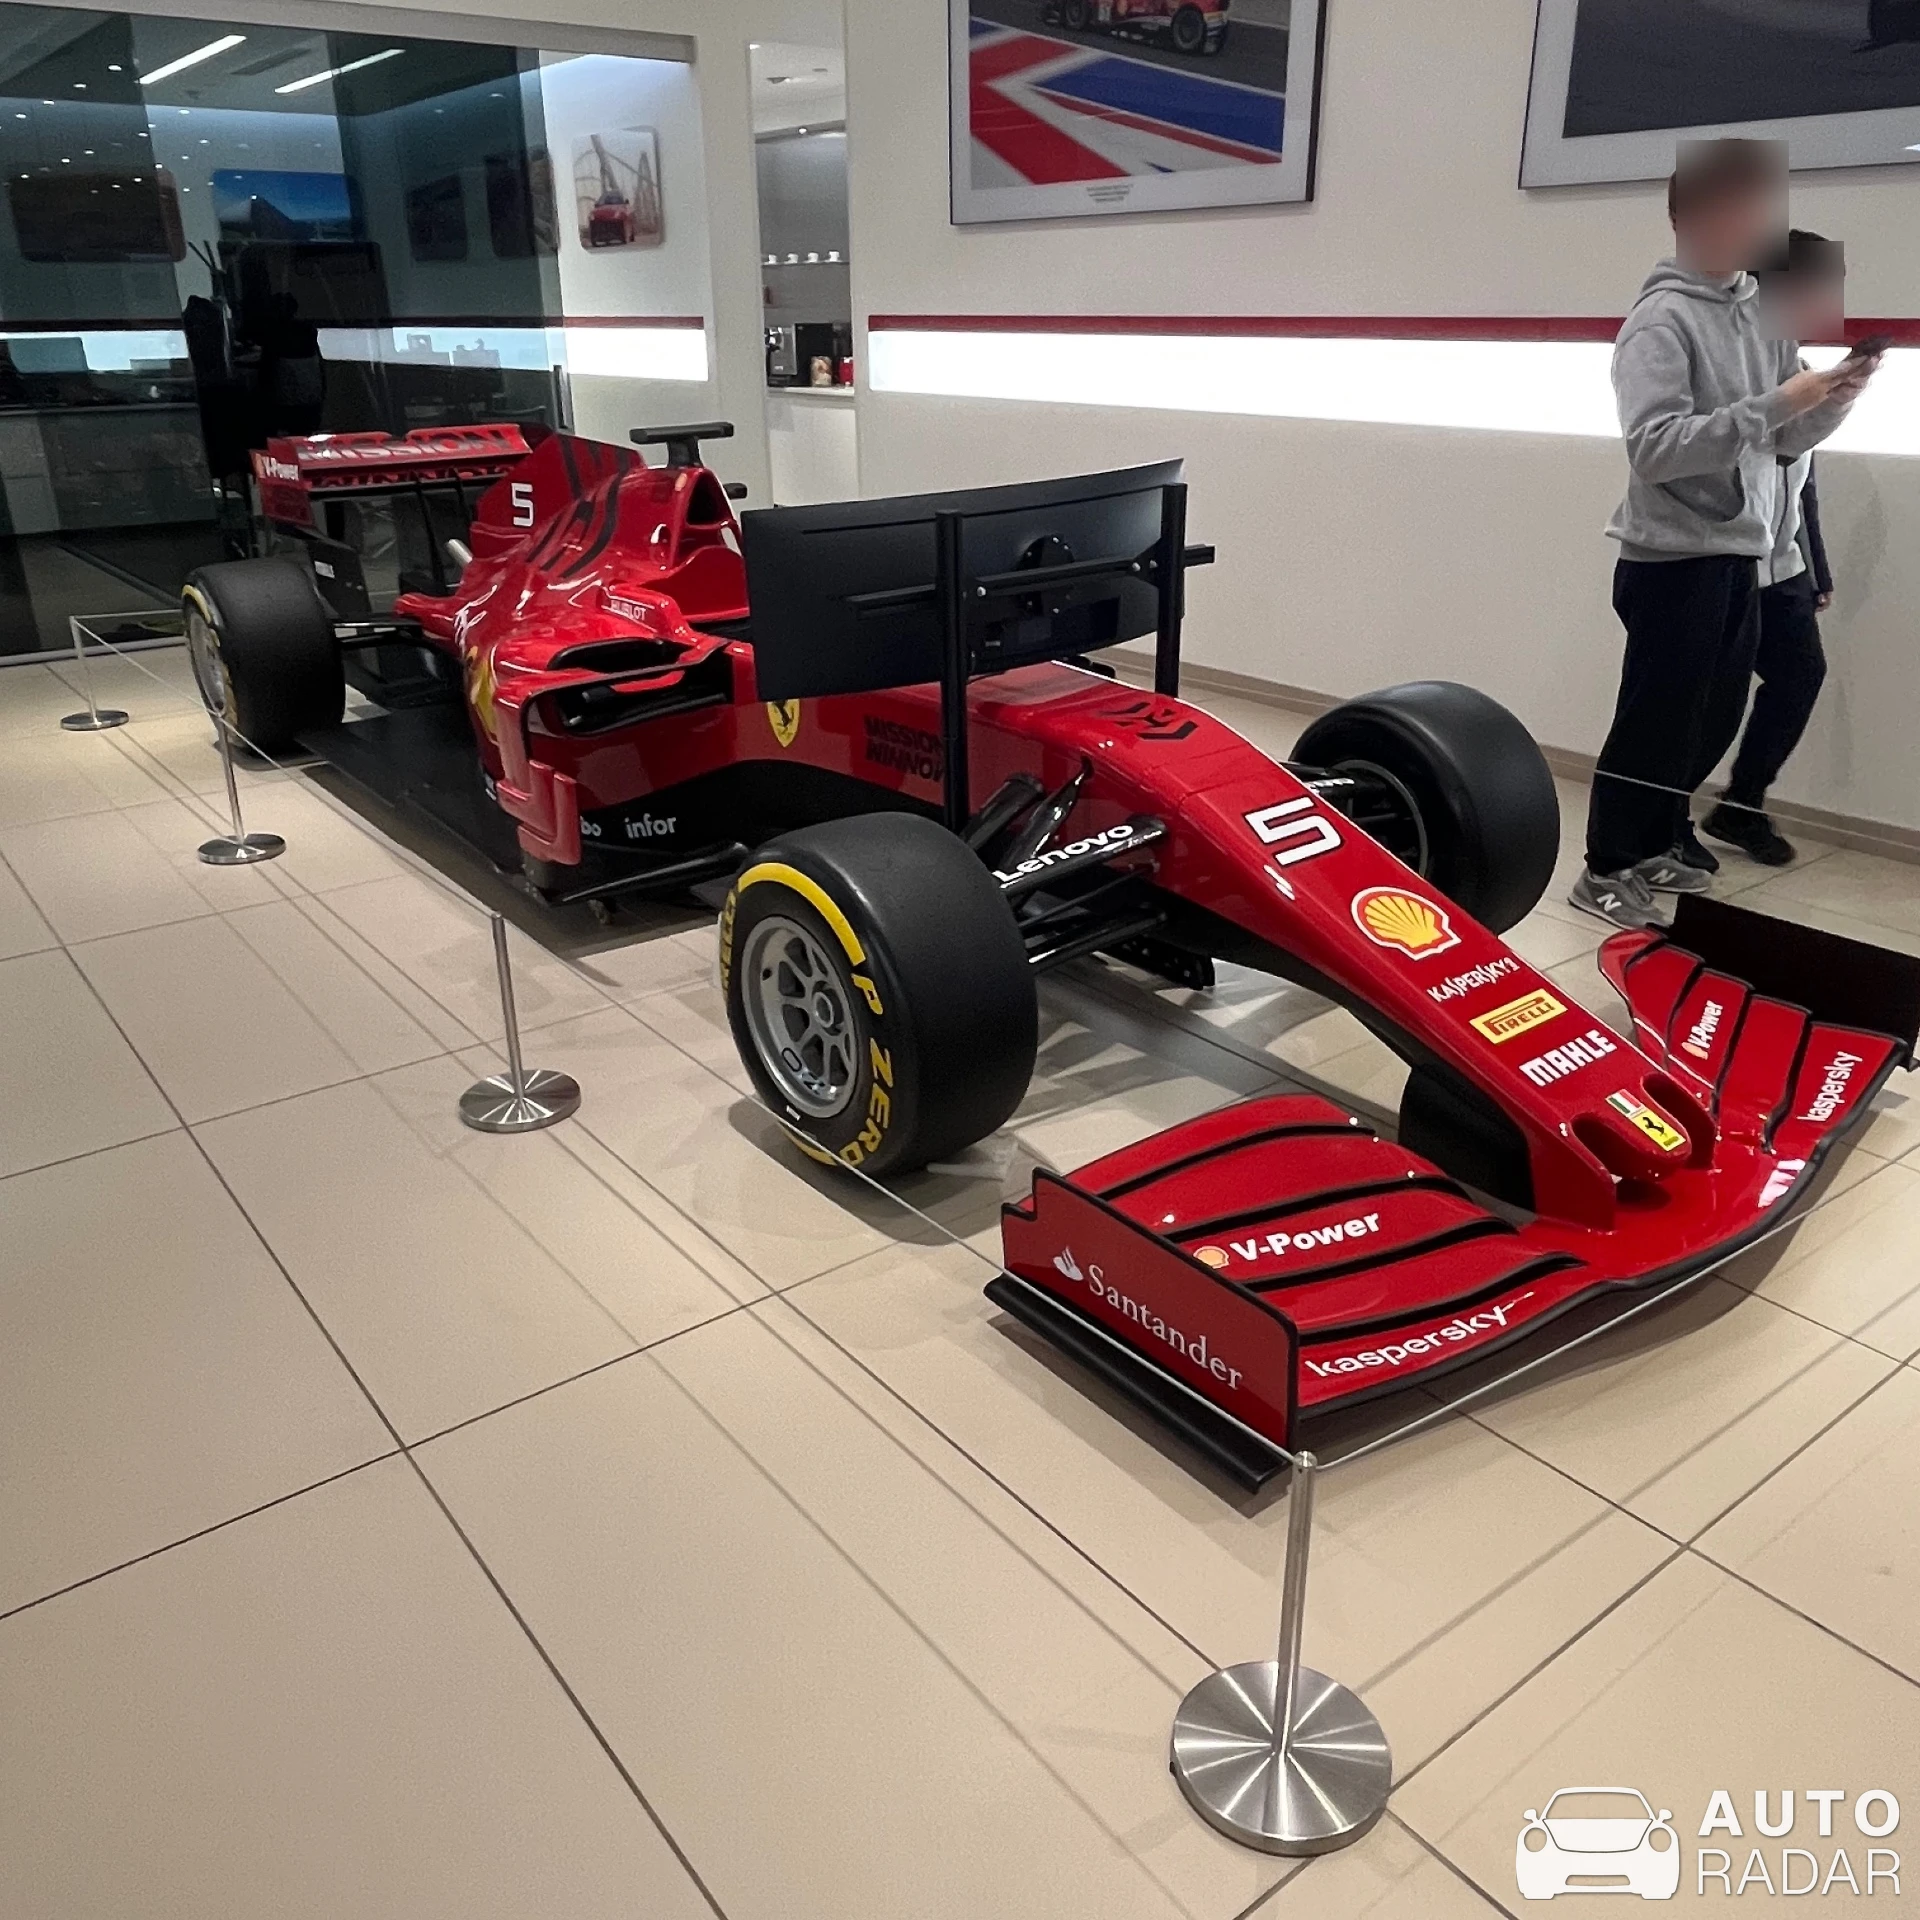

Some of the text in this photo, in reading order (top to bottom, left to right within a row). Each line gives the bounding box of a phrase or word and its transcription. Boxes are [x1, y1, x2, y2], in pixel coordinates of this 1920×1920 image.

[511, 482, 534, 527] 5
[624, 812, 677, 840] infor
[991, 824, 1134, 883] Lenovo
[1244, 796, 1342, 866] 5
[1482, 996, 1556, 1036] PIRELLI
[1687, 1000, 1724, 1050] V-Power
[839, 972, 894, 1169] P ZERO
[1518, 1028, 1618, 1087] MAHLE
[1796, 1051, 1863, 1122] kaspersky
[1230, 1211, 1381, 1262] V-Power
[1088, 1264, 1243, 1391] Santander
[1303, 1303, 1510, 1378] kaspersky
